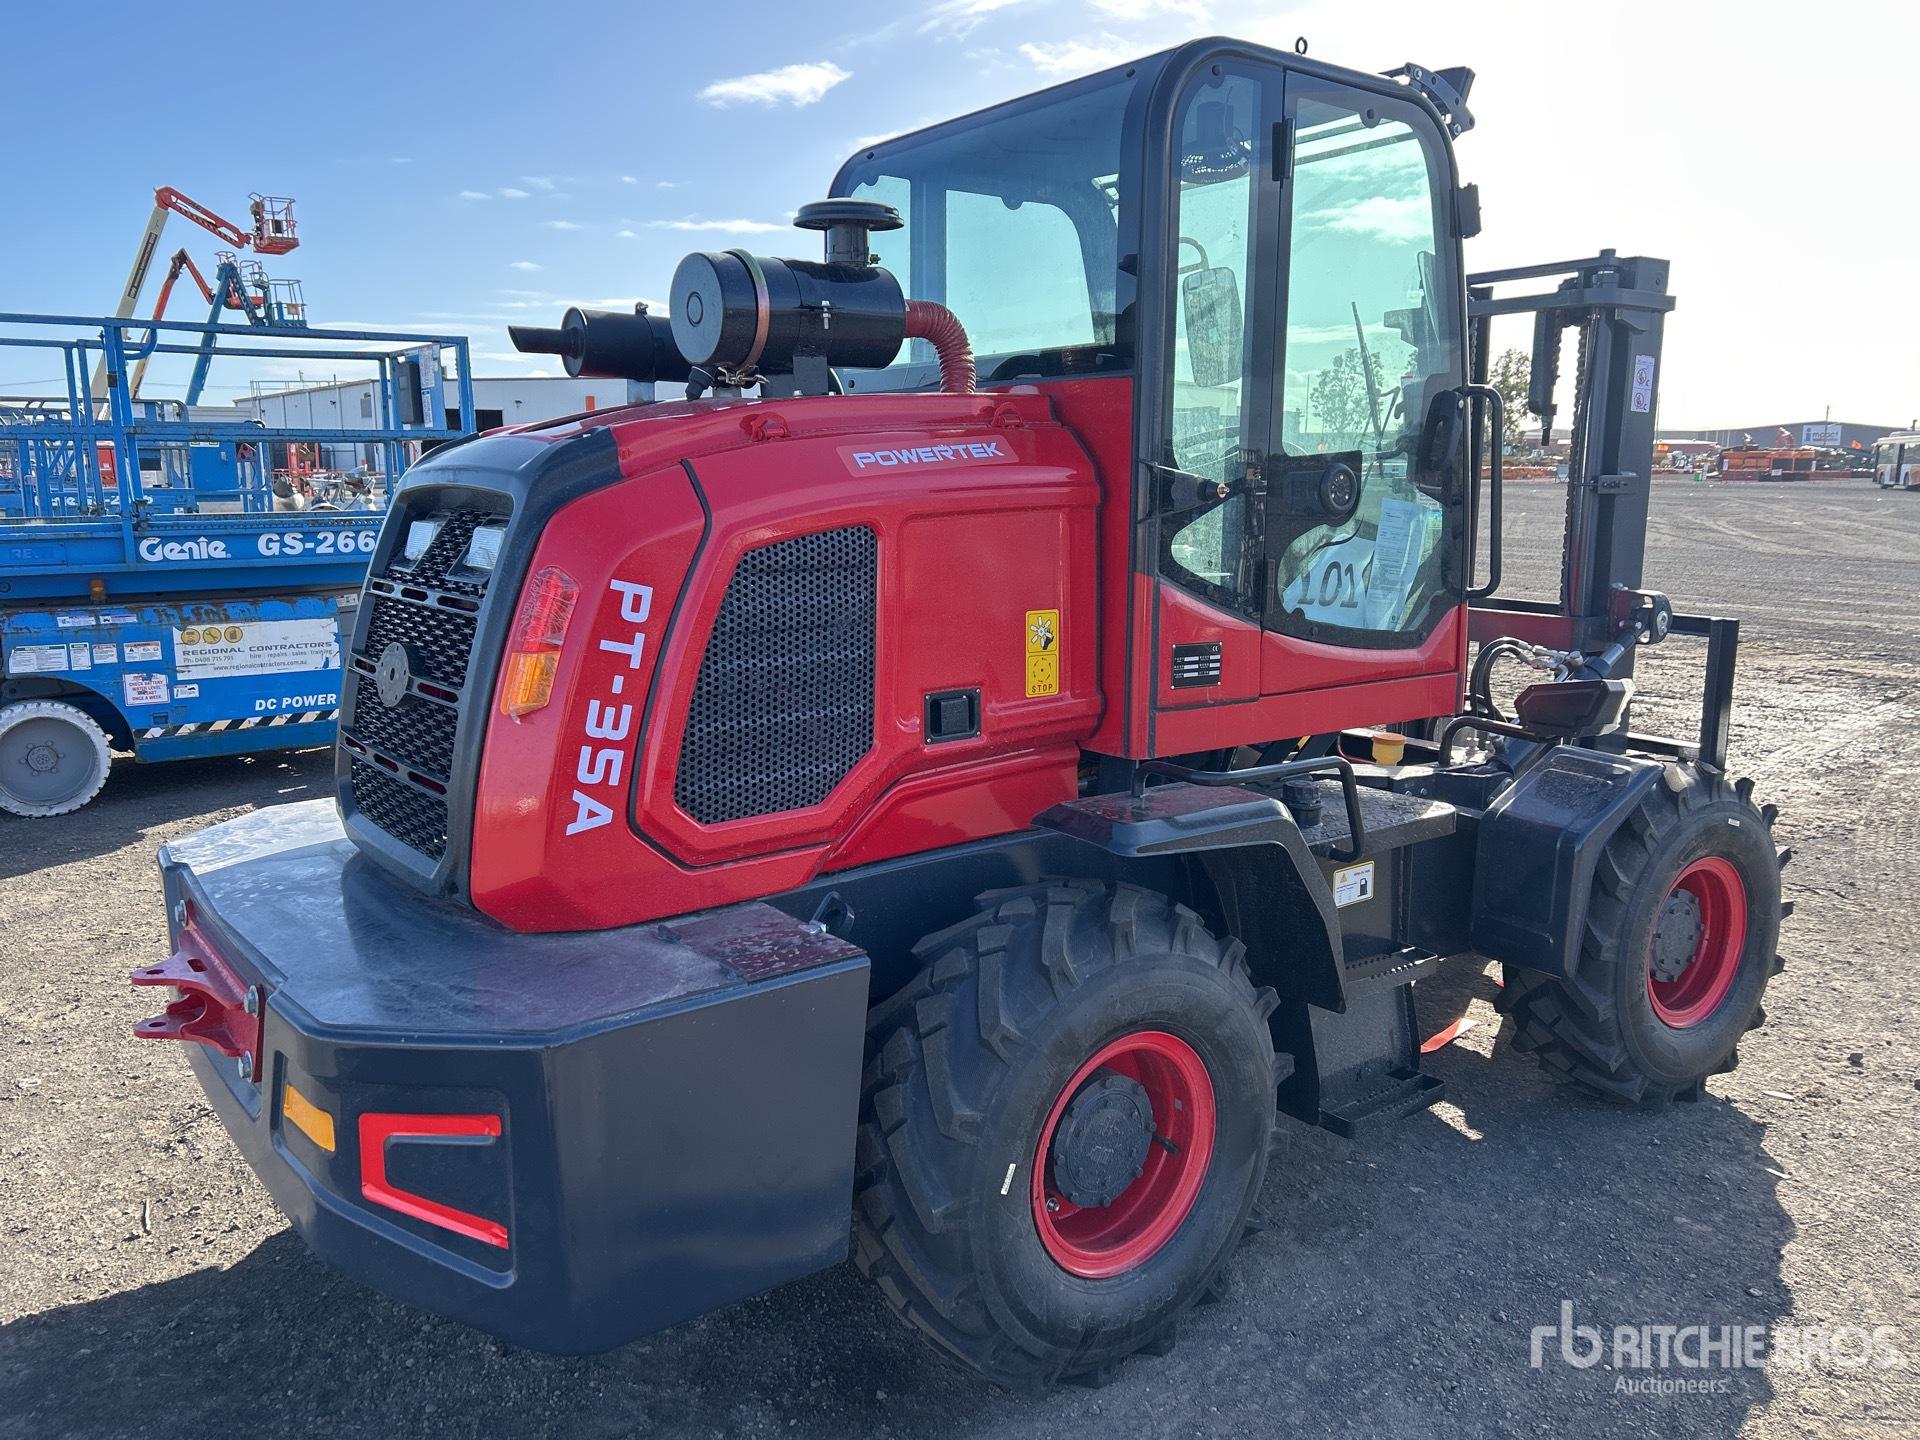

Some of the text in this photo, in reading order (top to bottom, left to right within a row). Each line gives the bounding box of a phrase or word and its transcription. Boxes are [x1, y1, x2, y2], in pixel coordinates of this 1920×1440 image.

[852, 442, 1005, 468] POWERTEK
[139, 536, 227, 561] Genie
[182, 641, 332, 656] REGIONAL CONTRACTORS
[267, 651, 288, 659] repairs
[310, 648, 333, 657] training
[213, 659, 307, 671] www.regionalcontractors.com.au
[1031, 683, 1053, 693] STOP
[255, 693, 337, 711] DC POWER
[565, 579, 653, 836] PT-35A
